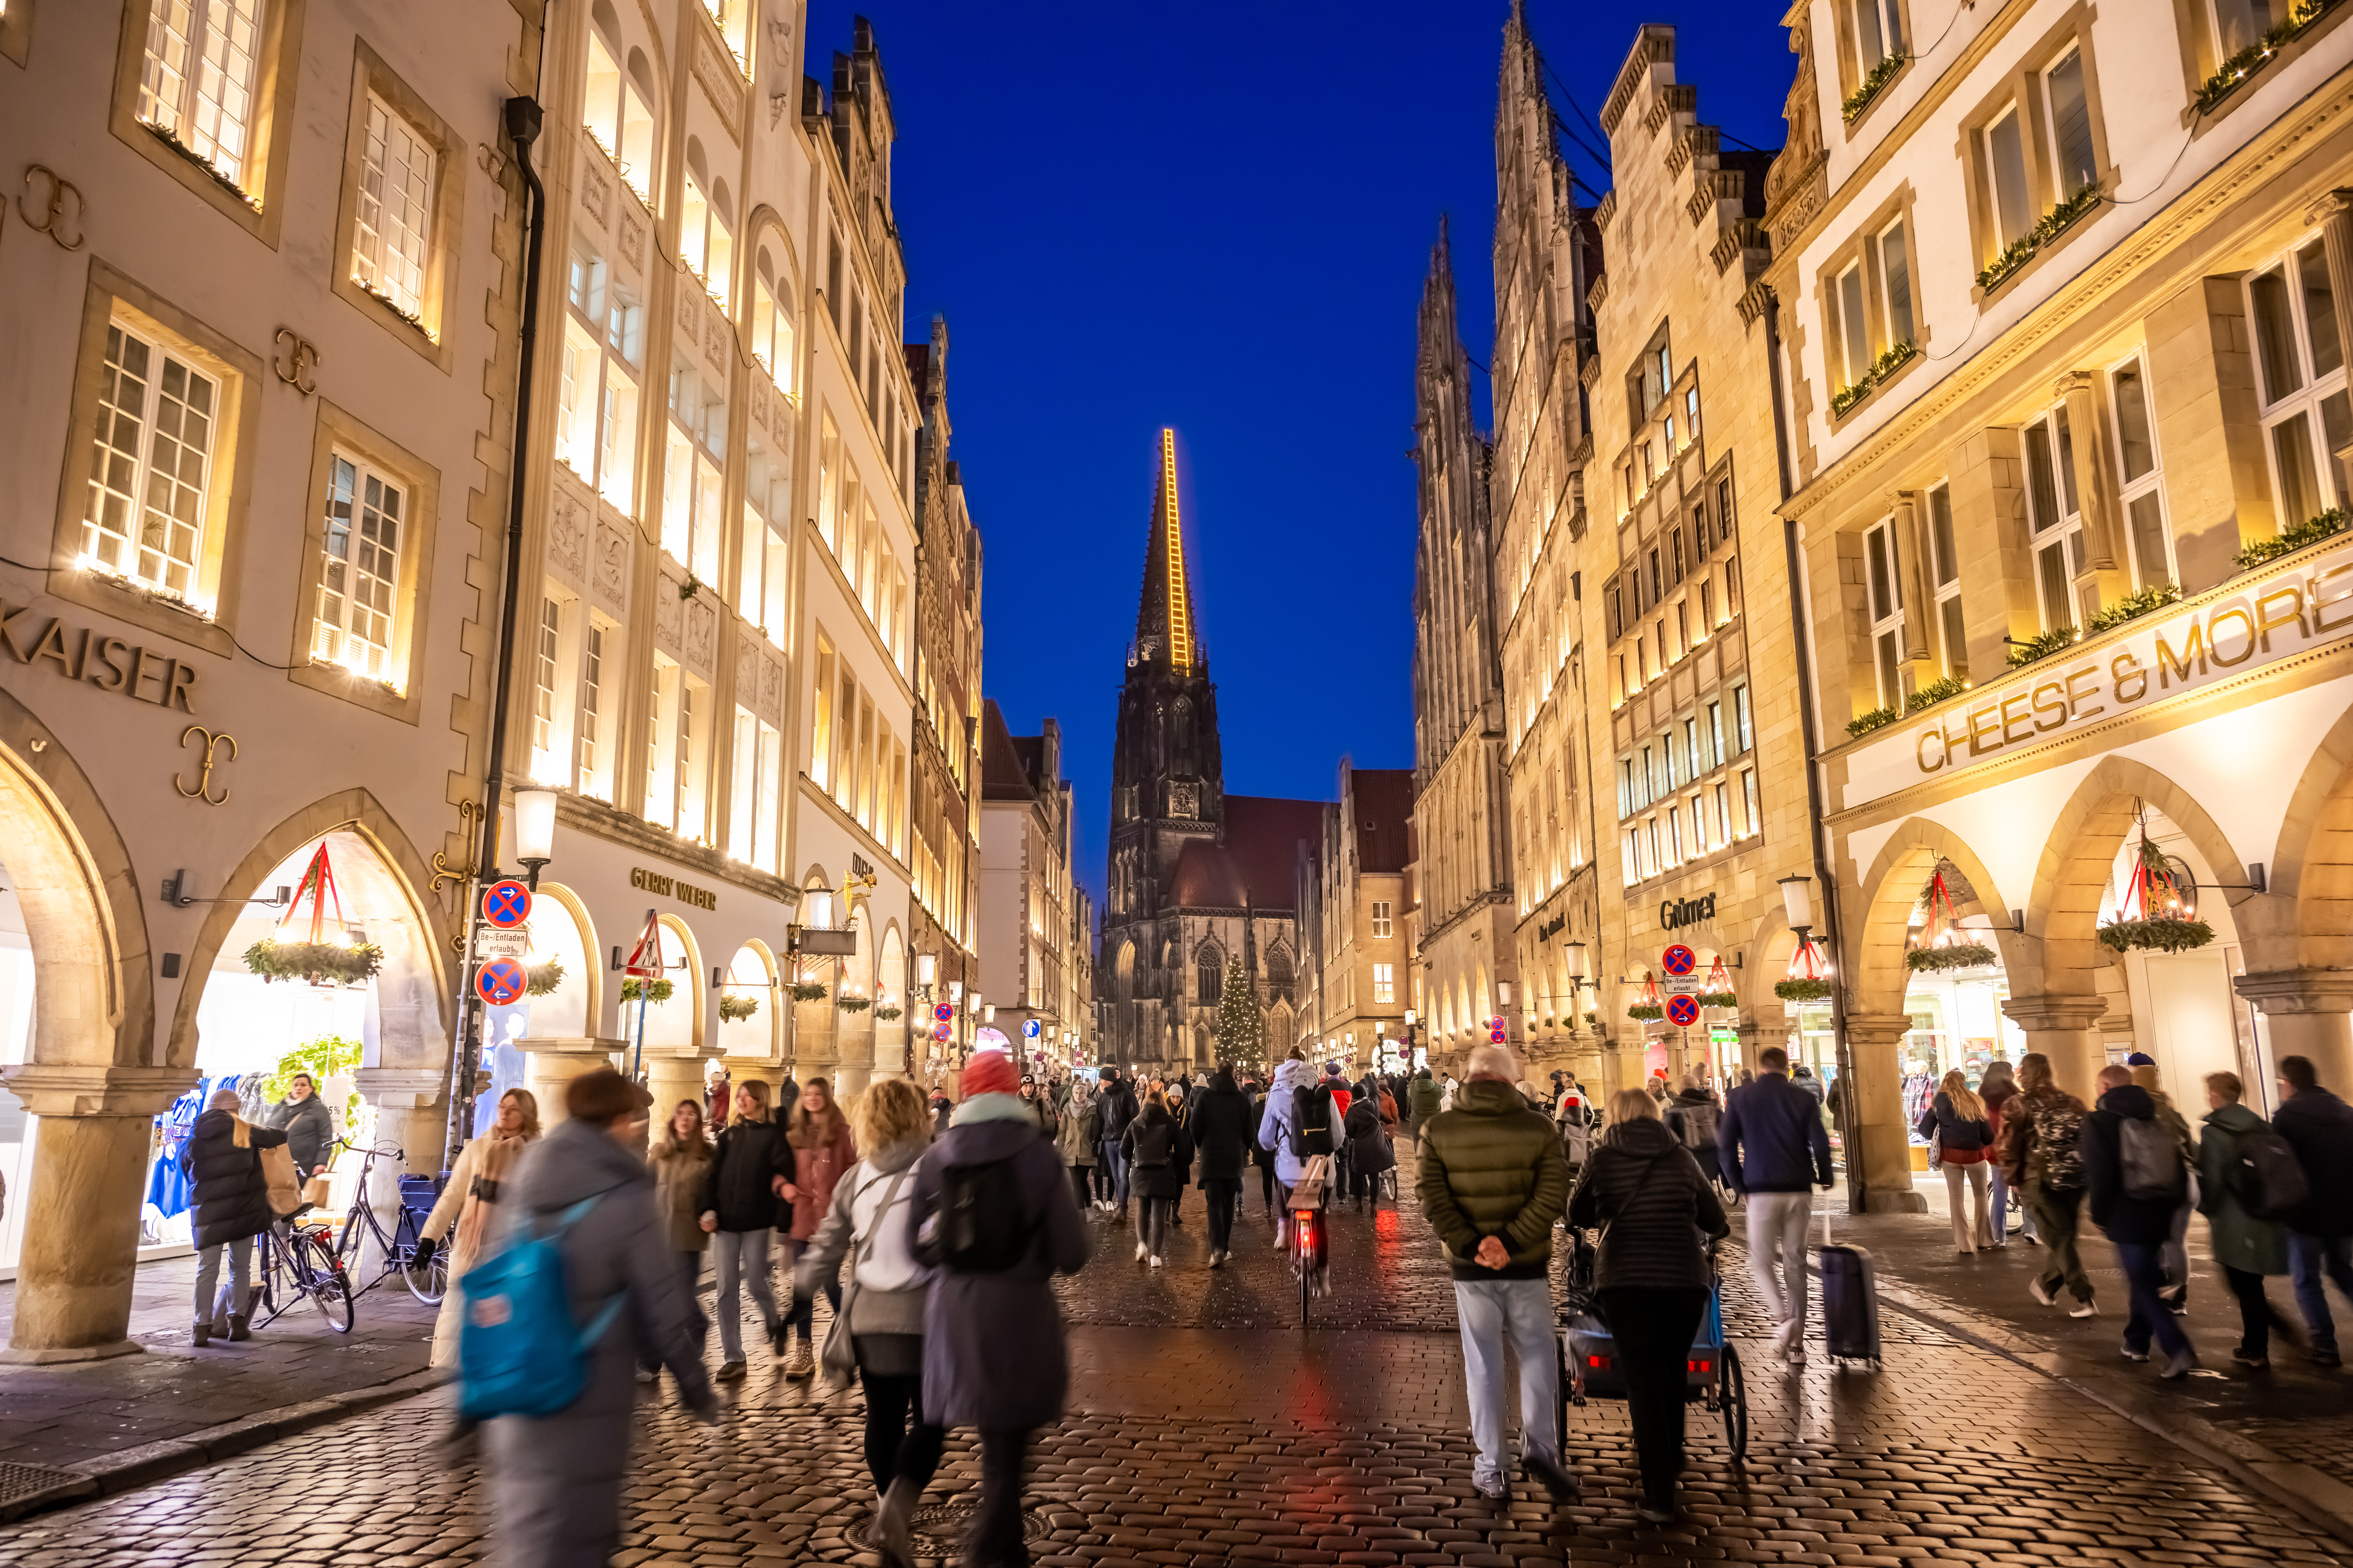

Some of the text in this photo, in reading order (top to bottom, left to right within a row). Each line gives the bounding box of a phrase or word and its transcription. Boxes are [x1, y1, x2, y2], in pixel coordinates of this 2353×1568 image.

[0, 597, 199, 715] KAISER
[1917, 562, 2353, 774] CHEESE & MORE
[631, 867, 716, 910] GERRY WEBER
[481, 933, 525, 942] Be-/Entladen
[489, 944, 514, 953] erlaubt
[326, 1106, 340, 1115] 5%
[156, 1127, 190, 1137] SOMEON
